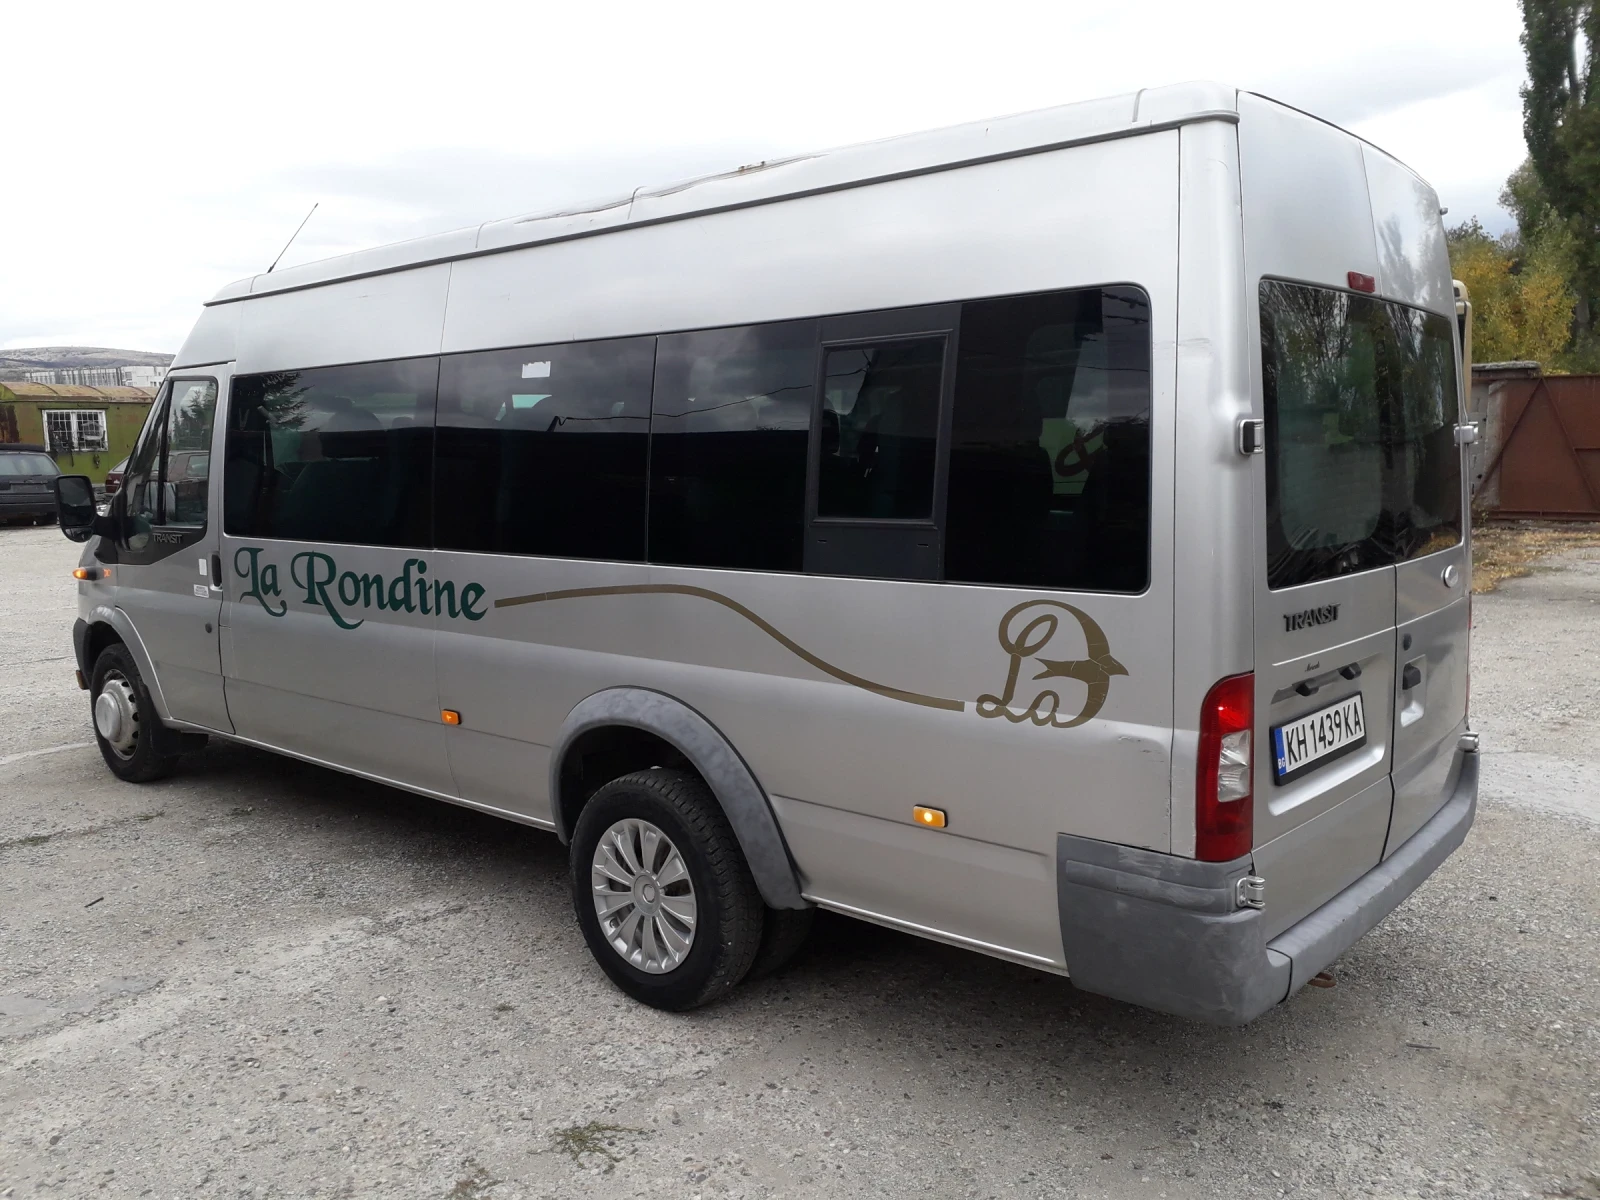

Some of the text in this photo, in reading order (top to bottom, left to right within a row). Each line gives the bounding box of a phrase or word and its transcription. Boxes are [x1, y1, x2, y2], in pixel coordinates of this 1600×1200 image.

[152, 533, 182, 544] TRANSIT
[234, 546, 489, 630] La Rondine
